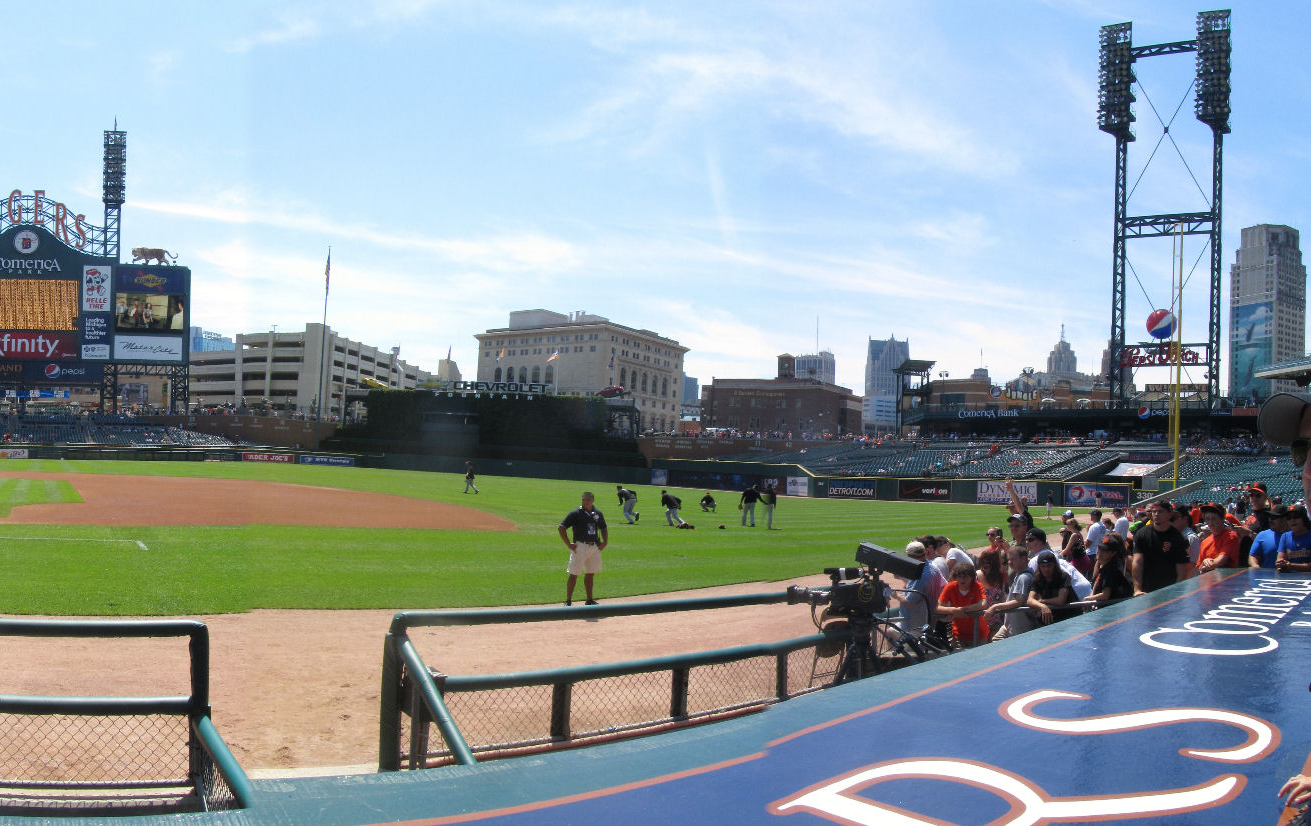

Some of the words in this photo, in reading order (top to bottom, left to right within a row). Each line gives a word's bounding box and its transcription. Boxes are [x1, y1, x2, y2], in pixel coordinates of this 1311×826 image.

[1119, 346, 1156, 368] PEPSI
[61, 367, 85, 376] pepsi
[453, 381, 550, 394] CHEVROLET
[435, 392, 533, 400] FOUNTAIN
[997, 408, 1019, 417] Bank
[829, 487, 874, 496] DETROIT.COM
[921, 488, 948, 496] verizon
[979, 482, 1035, 494] DYNMIC
